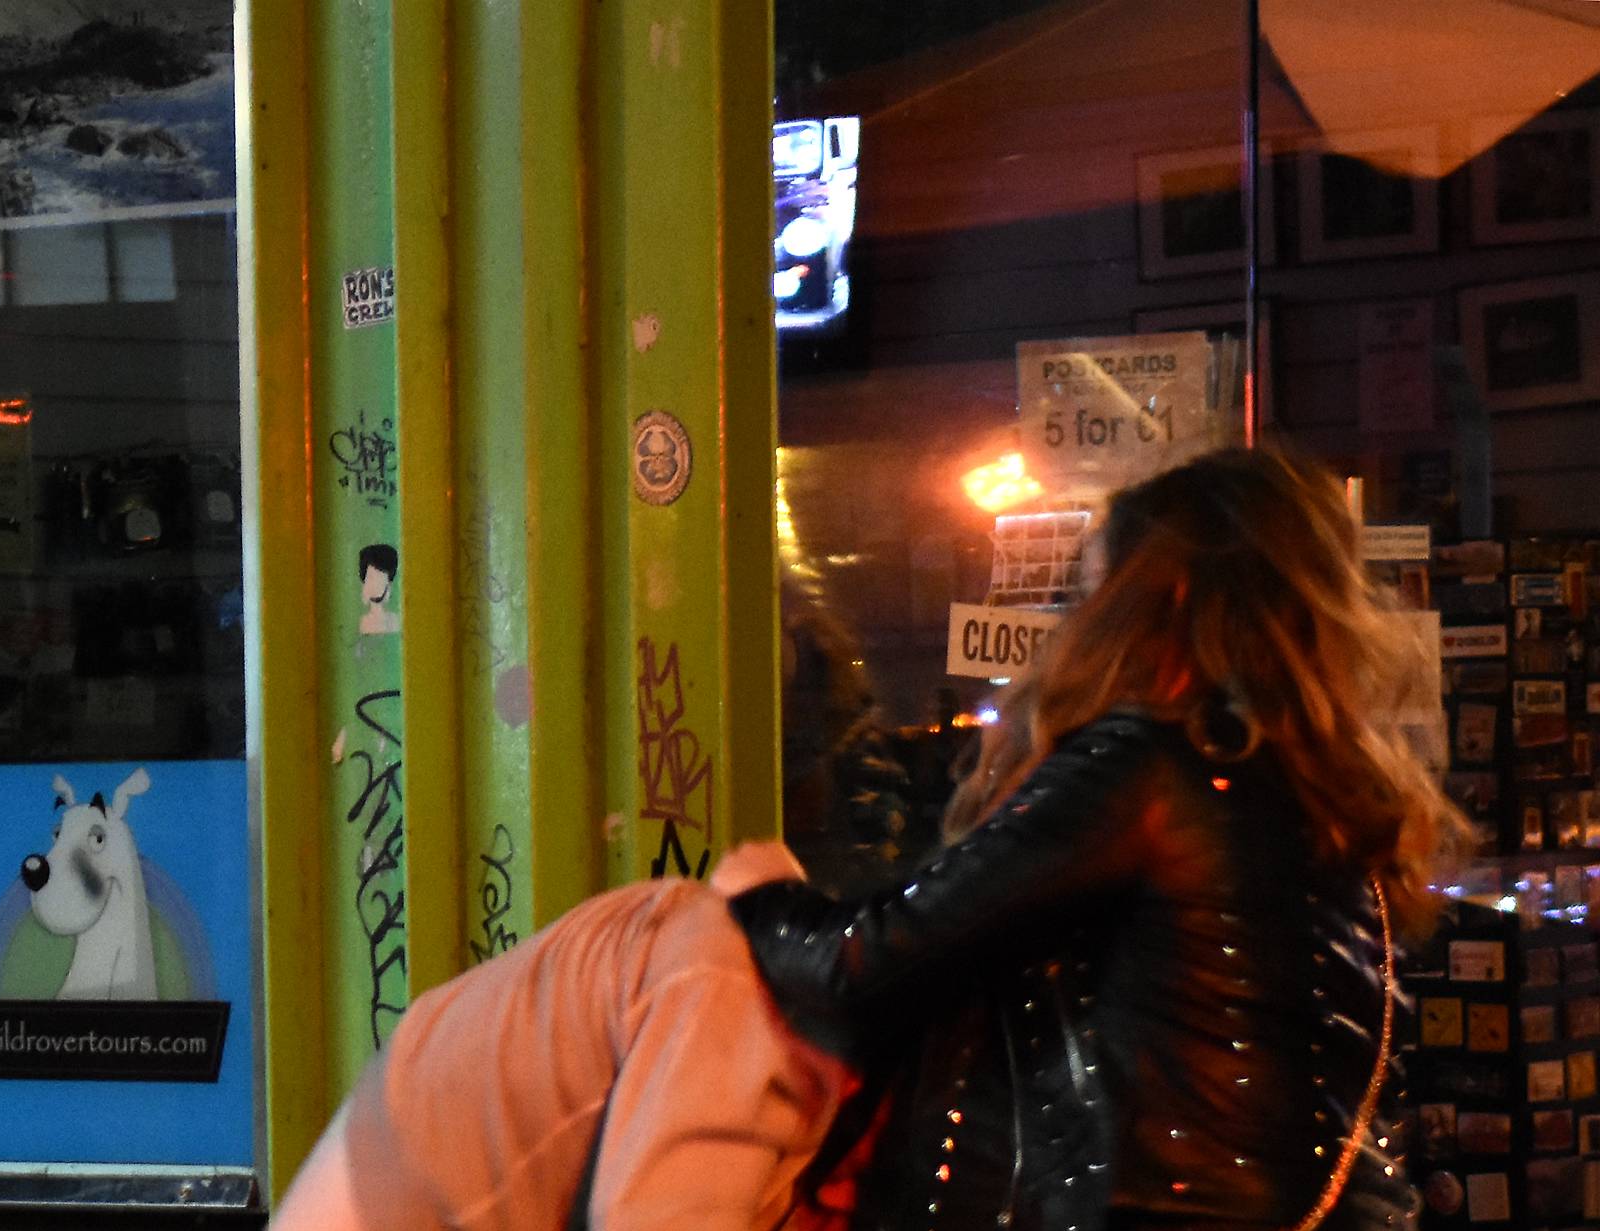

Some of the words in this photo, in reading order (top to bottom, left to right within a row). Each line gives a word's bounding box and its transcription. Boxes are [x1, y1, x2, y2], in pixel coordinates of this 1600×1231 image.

[1043, 354, 1176, 378] POSCARDS
[1045, 411, 1064, 447] 5
[1076, 409, 1124, 445] for
[962, 618, 1046, 666] CLOSE
